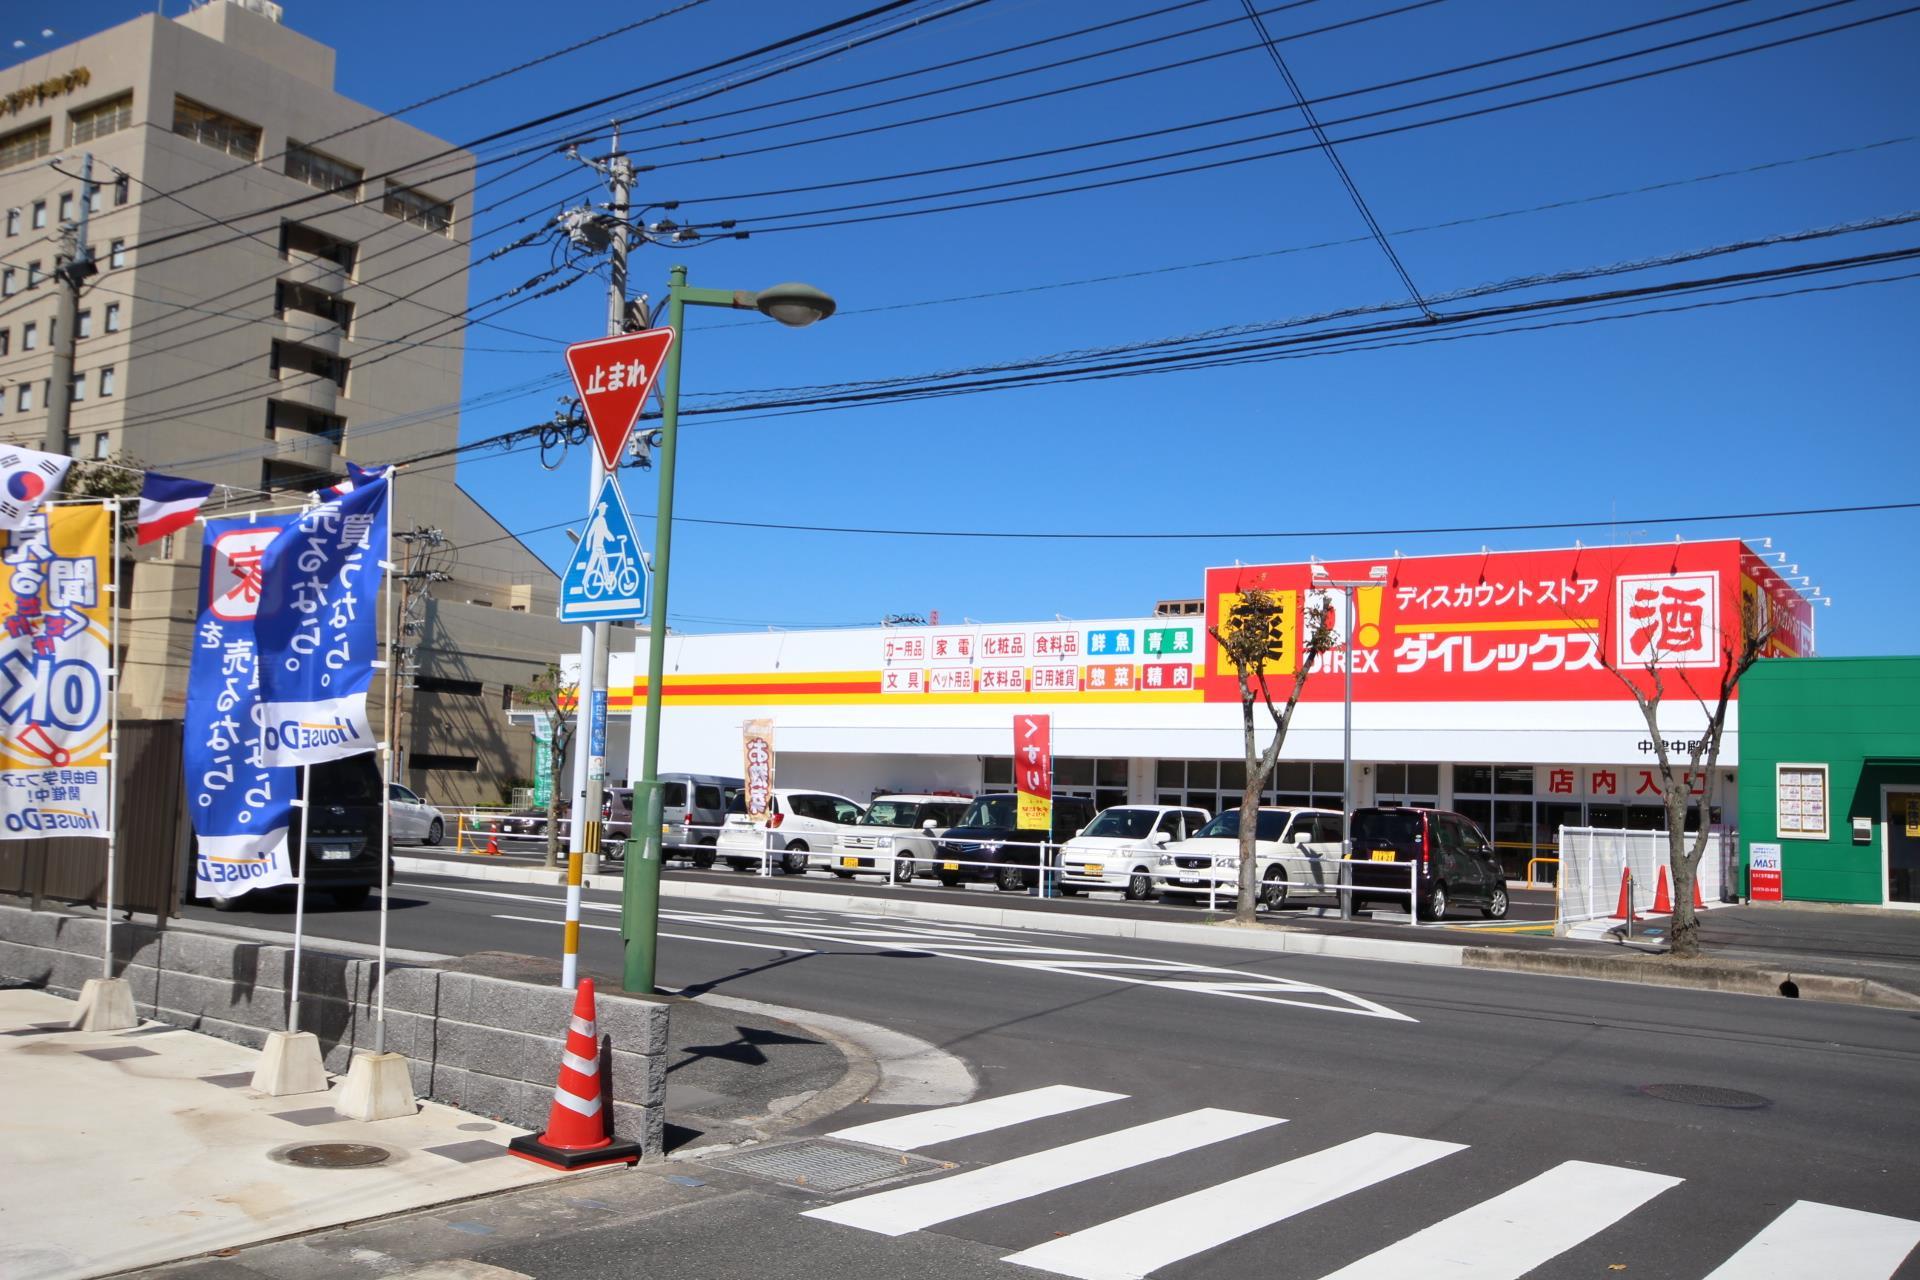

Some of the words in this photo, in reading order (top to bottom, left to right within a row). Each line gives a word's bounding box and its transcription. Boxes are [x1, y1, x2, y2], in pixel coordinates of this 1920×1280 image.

[586, 358, 647, 394] 止まれ
[1629, 585, 1706, 657] 酒
[886, 640, 922, 657] カー用品
[936, 638, 969, 656] 家電
[984, 637, 1023, 654] 化粧品
[1036, 635, 1076, 653] 食料品
[1091, 632, 1130, 652] 鮮魚
[1148, 631, 1189, 651] 青果
[1394, 632, 1606, 673] ダイレックス
[887, 671, 920, 689] 文具
[933, 671, 970, 688] ペット用品
[983, 670, 1022, 687] 衣料品
[1035, 669, 1075, 687] 日用雑貨
[1091, 667, 1129, 687] 惣菜
[1147, 666, 1188, 686] 精肉
[1549, 769, 1707, 795] 店内入口
[1753, 859, 1777, 868] MAST
